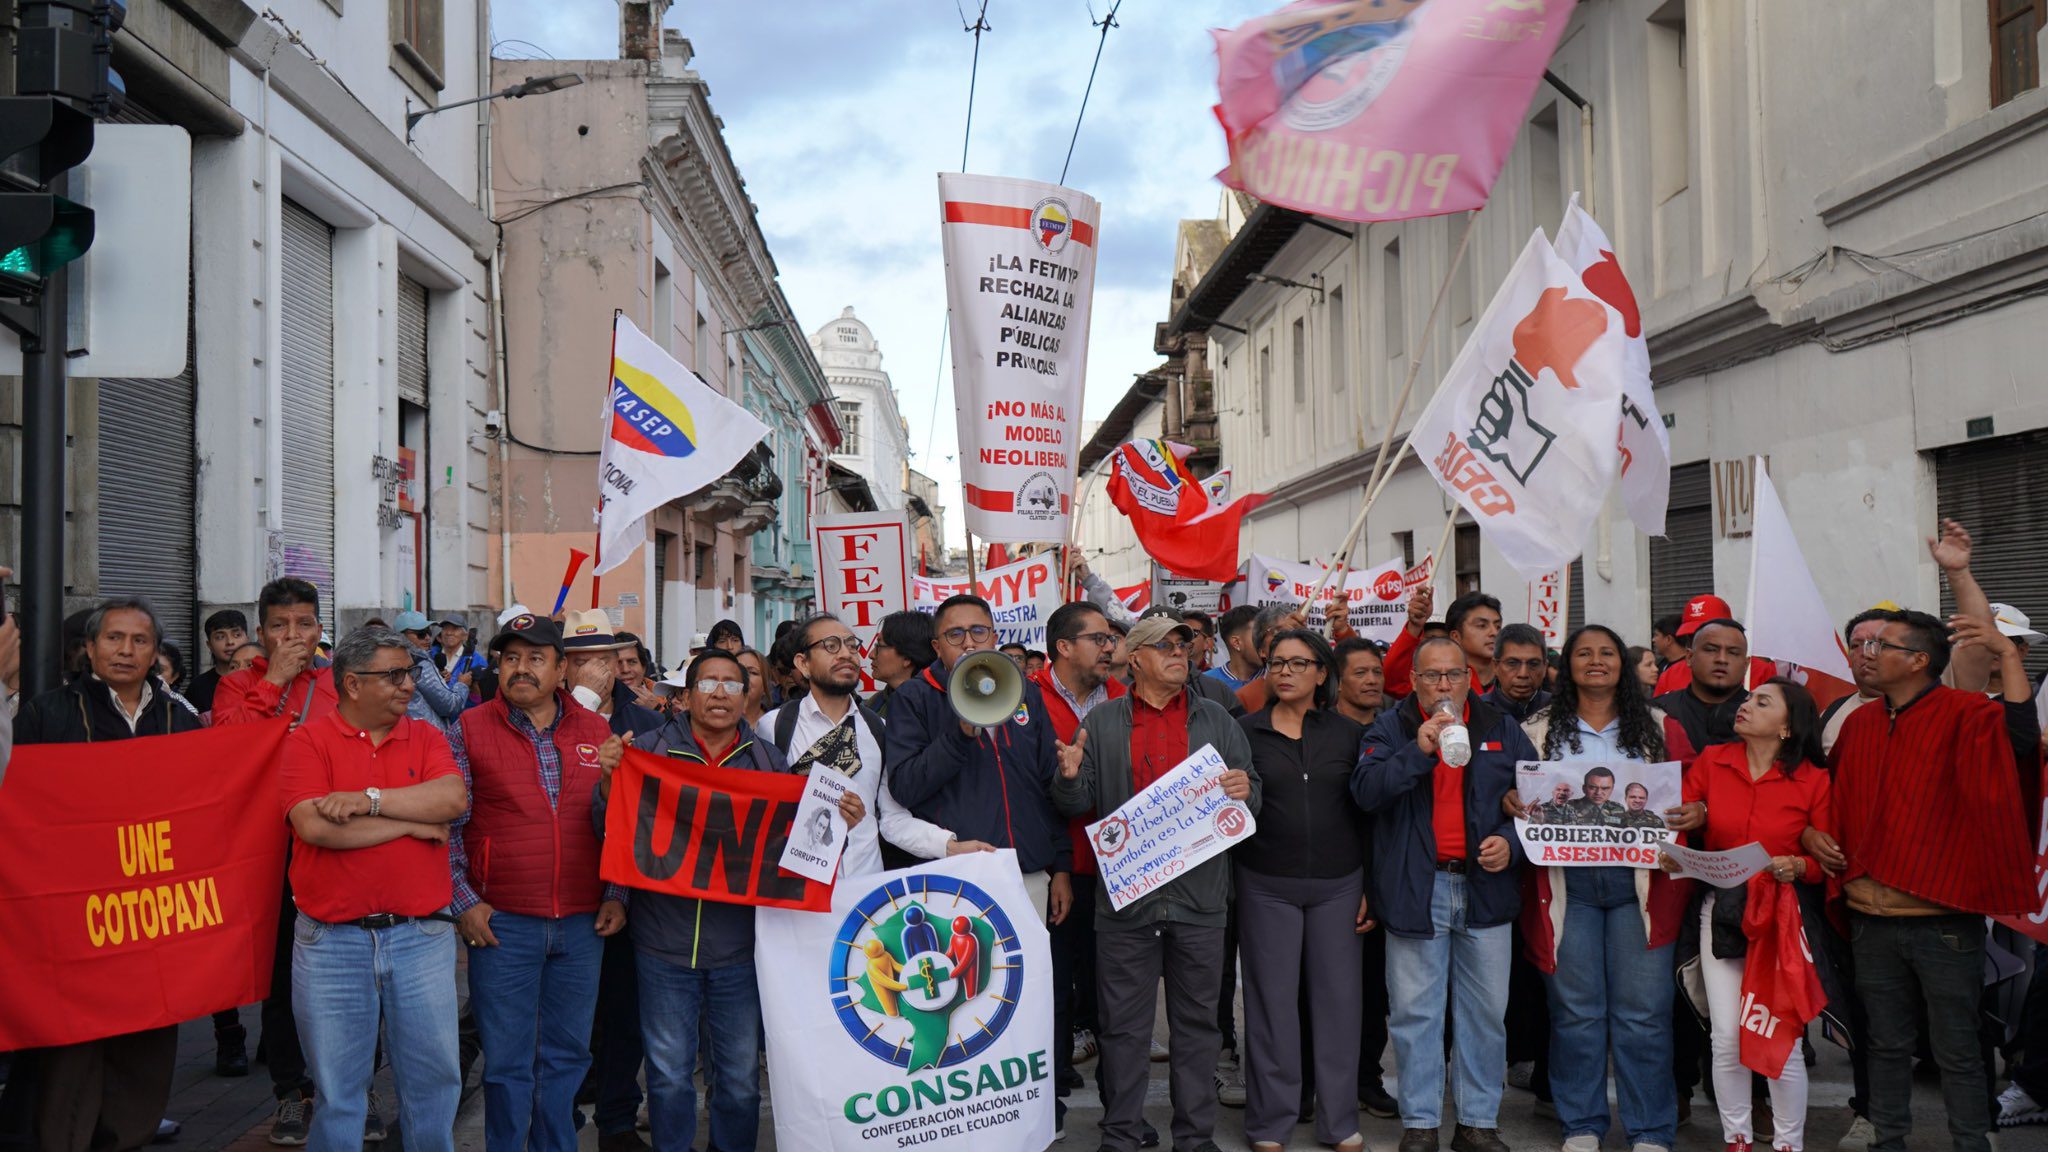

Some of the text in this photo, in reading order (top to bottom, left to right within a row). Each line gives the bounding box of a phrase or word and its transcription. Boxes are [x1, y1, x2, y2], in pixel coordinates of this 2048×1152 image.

[989, 253, 1078, 285] ¡LA FETMYP
[980, 276, 1059, 305] RECHAZA
[1001, 303, 1067, 331] ALIANZAS
[1000, 326, 1061, 353] PÚBLICAS
[988, 400, 1066, 422] ¡NO MÁS AL
[1005, 425, 1062, 444] MODELO
[980, 448, 1067, 469] NEOLIBERAL
[1138, 487, 1148, 500] EL
[913, 564, 1048, 607] FETMYP
[1295, 582, 1364, 601] RECHZO
[992, 604, 1037, 623] UESTRA
[1258, 600, 1264, 609] A
[1348, 604, 1406, 615] NISTERIALES
[1538, 570, 1558, 639] ETMYP
[1008, 628, 1016, 645] Y
[1017, 630, 1031, 644] LA
[819, 775, 846, 792] EVASOR
[1190, 765, 1203, 779] de
[812, 788, 841, 807] BANANE
[1182, 766, 1229, 805] Sindicl
[1158, 826, 1177, 842] es
[1177, 816, 1195, 831] la
[1218, 810, 1242, 834] FUT
[117, 820, 174, 877] UNE
[633, 773, 806, 902] UNE
[1525, 827, 1669, 844] GOBIERNO DE
[790, 847, 828, 868] CORRUPTO
[1542, 846, 1656, 864] ASESINOS
[1109, 845, 1182, 895] de los servicios
[86, 877, 224, 948] COTOPAXI
[1740, 991, 1782, 1039] lar
[843, 1049, 1048, 1125] CONSADE
[861, 1106, 965, 1140] CONFEDERACIÓN
[1026, 1087, 1040, 1100] DE
[897, 1109, 1020, 1148] SALUD DEL ECUADOR
